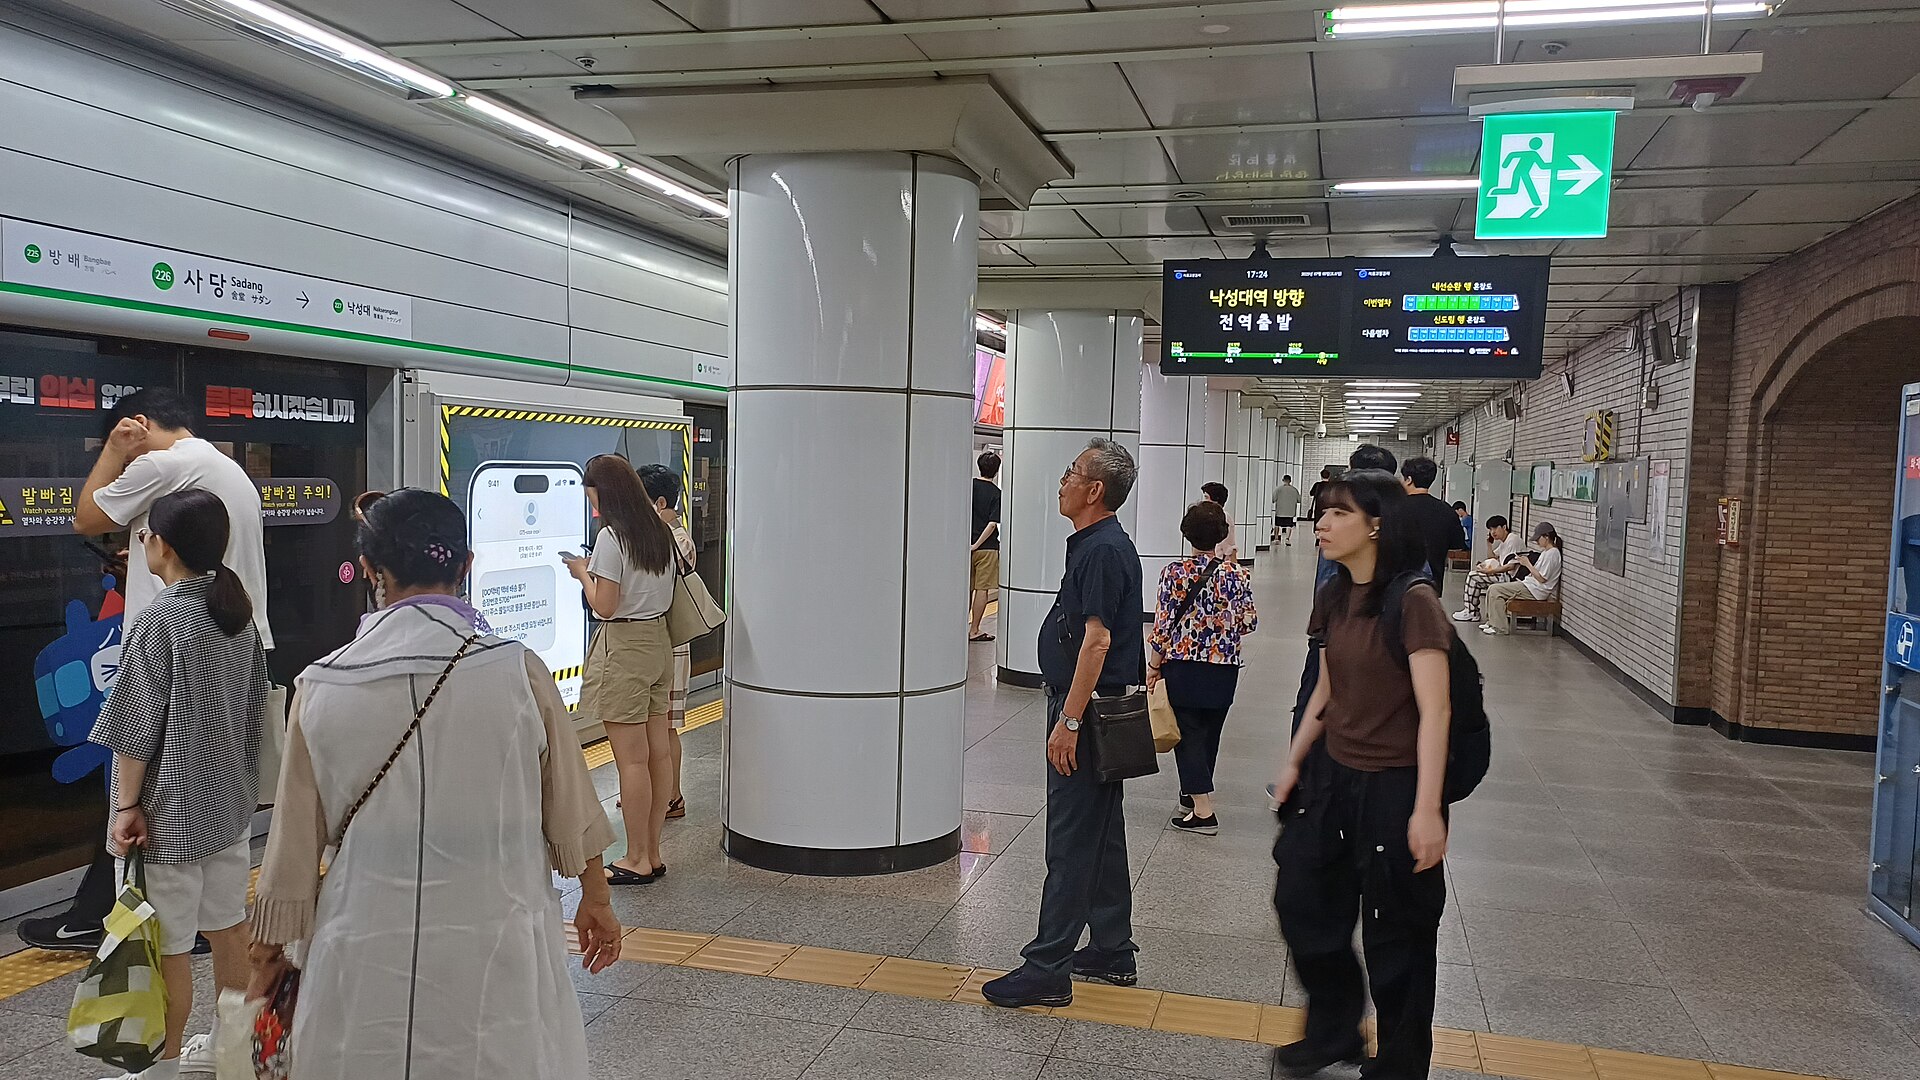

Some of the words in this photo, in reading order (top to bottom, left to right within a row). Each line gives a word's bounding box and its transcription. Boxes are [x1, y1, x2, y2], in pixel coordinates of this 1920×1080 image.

[26, 248, 40, 258] 225
[83, 255, 112, 266] Bangbae
[155, 269, 172, 282] 226
[1246, 270, 1269, 279] 17:24
[183, 269, 227, 298] 사당
[231, 276, 263, 293] Sadang
[1209, 288, 1268, 307] 낙성대역
[1273, 288, 1305, 308] 방향
[1363, 298, 1392, 308] 이번열차
[347, 301, 371, 317] 낙성대
[1361, 328, 1390, 338] 다음열차
[40, 374, 96, 410] 의심
[488, 479, 500, 488] 9:41
[22, 486, 73, 506] 발빠짐
[261, 485, 296, 501] 발빠짐
[303, 484, 331, 500] 주의!
[22, 507, 42, 515] Watch
[43, 508, 58, 516] your
[22, 516, 43, 526] 열차와
[45, 516, 66, 525] 승강장
